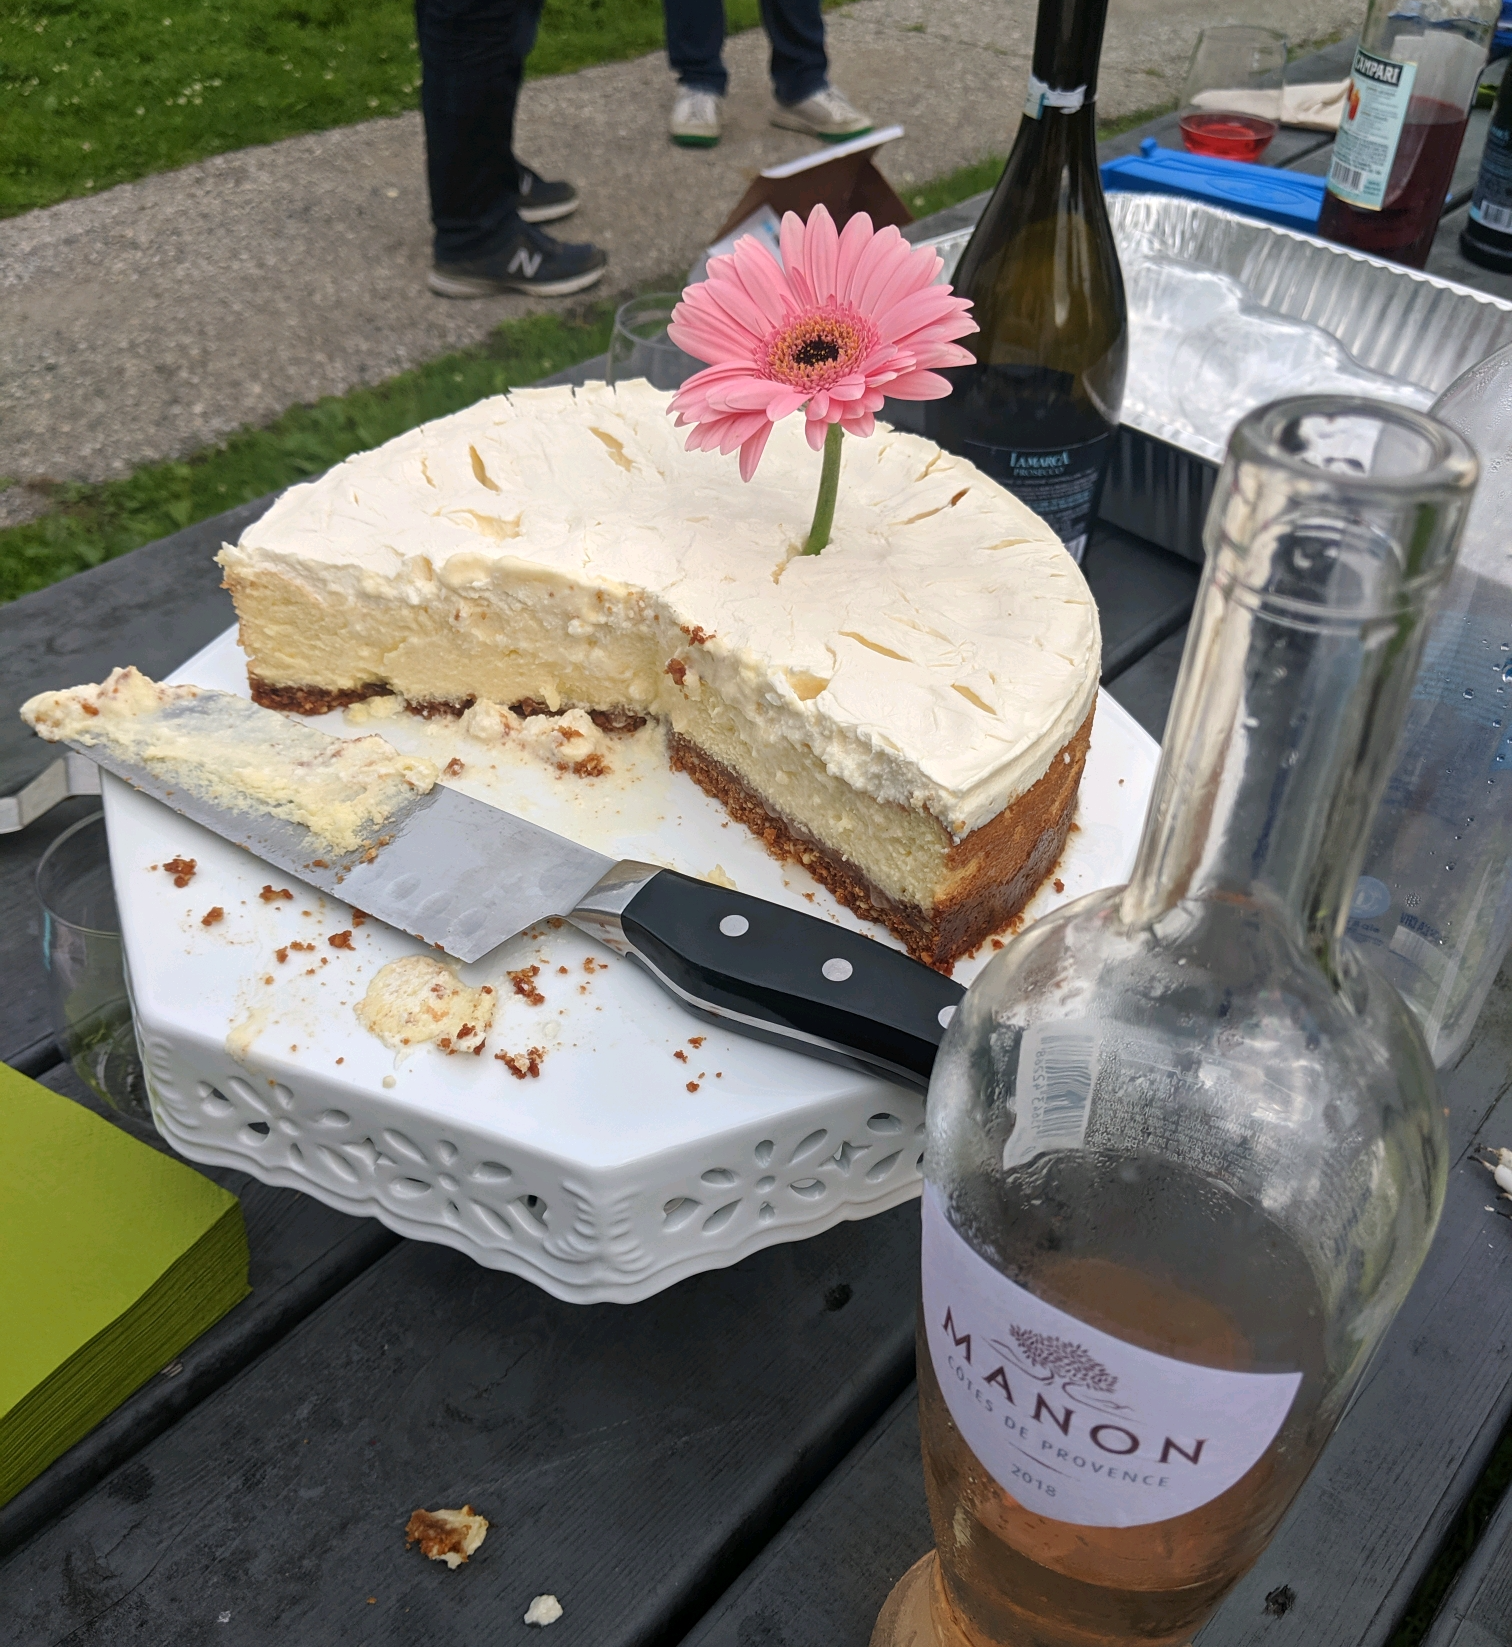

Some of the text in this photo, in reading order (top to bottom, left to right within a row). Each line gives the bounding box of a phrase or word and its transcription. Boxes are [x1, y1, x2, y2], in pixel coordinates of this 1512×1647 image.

[1354, 53, 1400, 84] CAMPARI
[506, 247, 542, 278] N
[941, 1305, 1206, 1465] MANON
[1004, 1416, 1030, 1440] DE
[1041, 1439, 1171, 1488] PROVENCE
[1011, 1463, 1057, 1497] 2018
